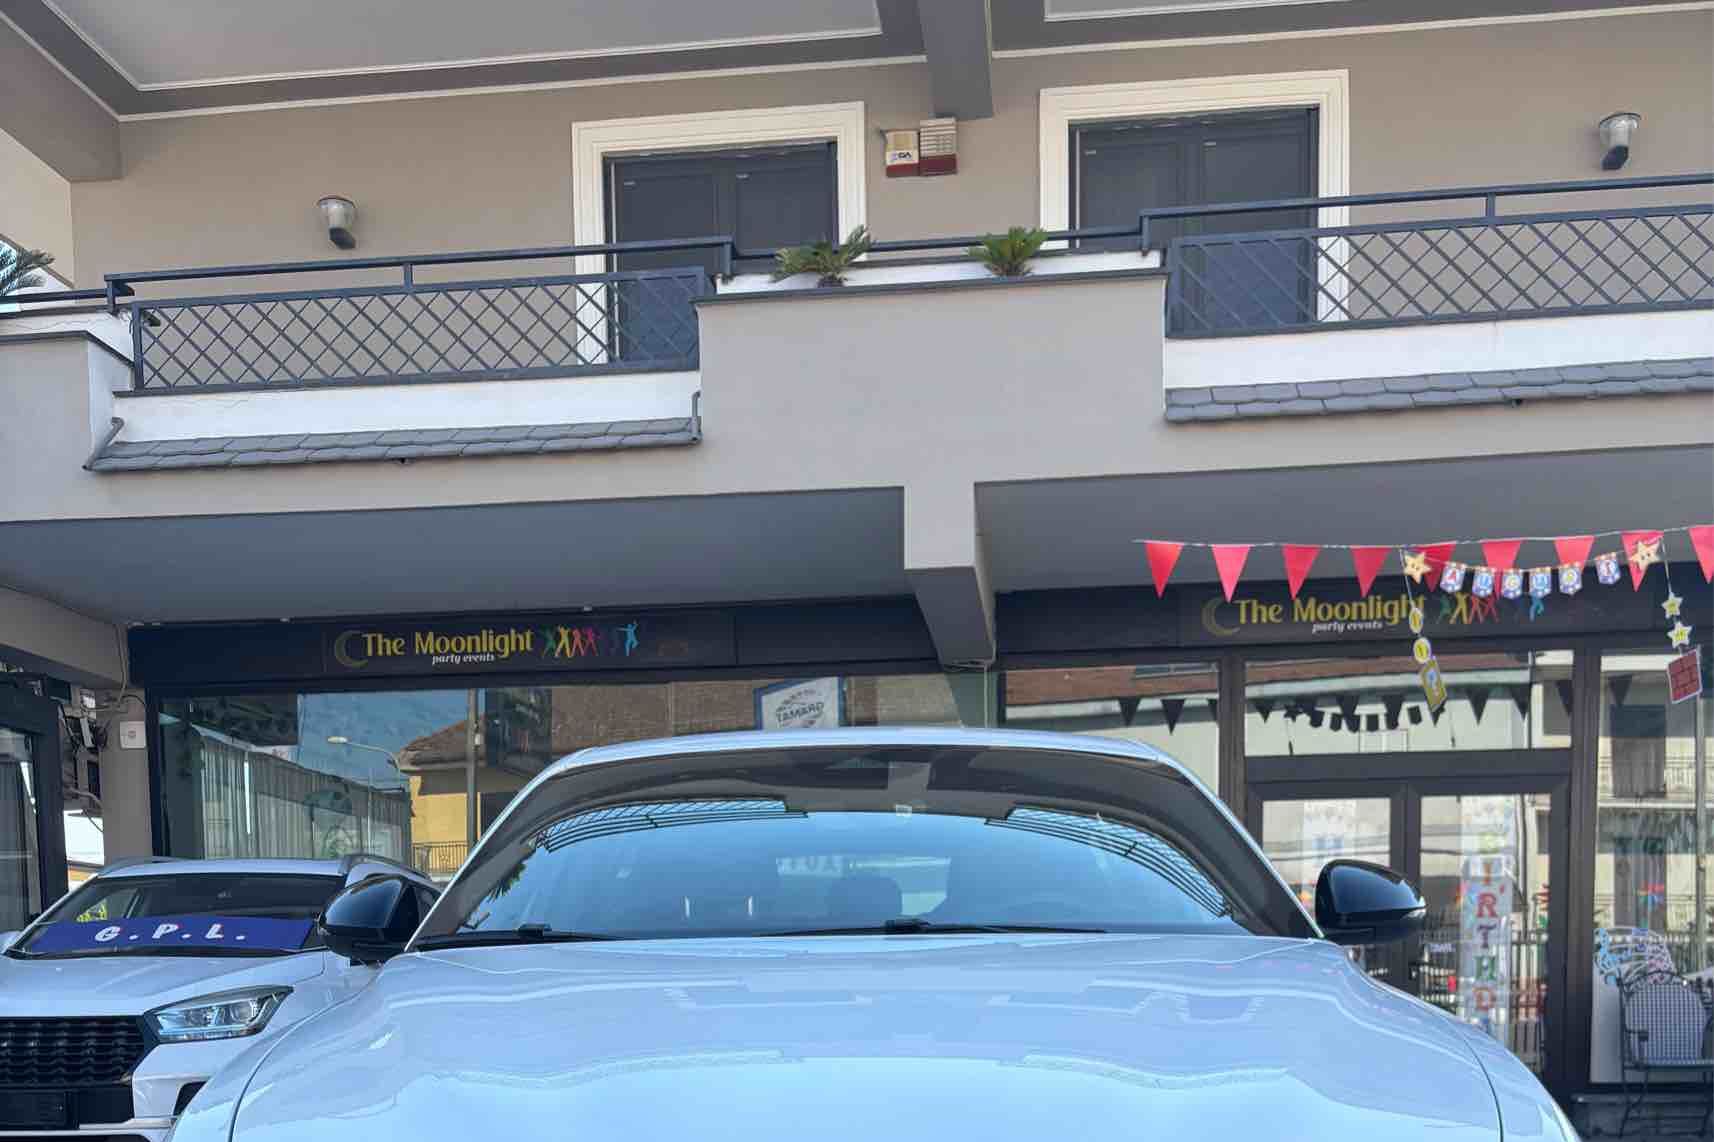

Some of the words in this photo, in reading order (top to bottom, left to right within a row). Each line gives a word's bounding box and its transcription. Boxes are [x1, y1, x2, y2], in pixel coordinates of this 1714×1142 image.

[1233, 598, 1283, 625] The
[1312, 623, 1345, 634] party
[1347, 621, 1383, 631] events
[362, 633, 405, 657] The
[415, 629, 534, 657] Moonlight
[432, 654, 461, 665] party
[463, 653, 495, 663] events
